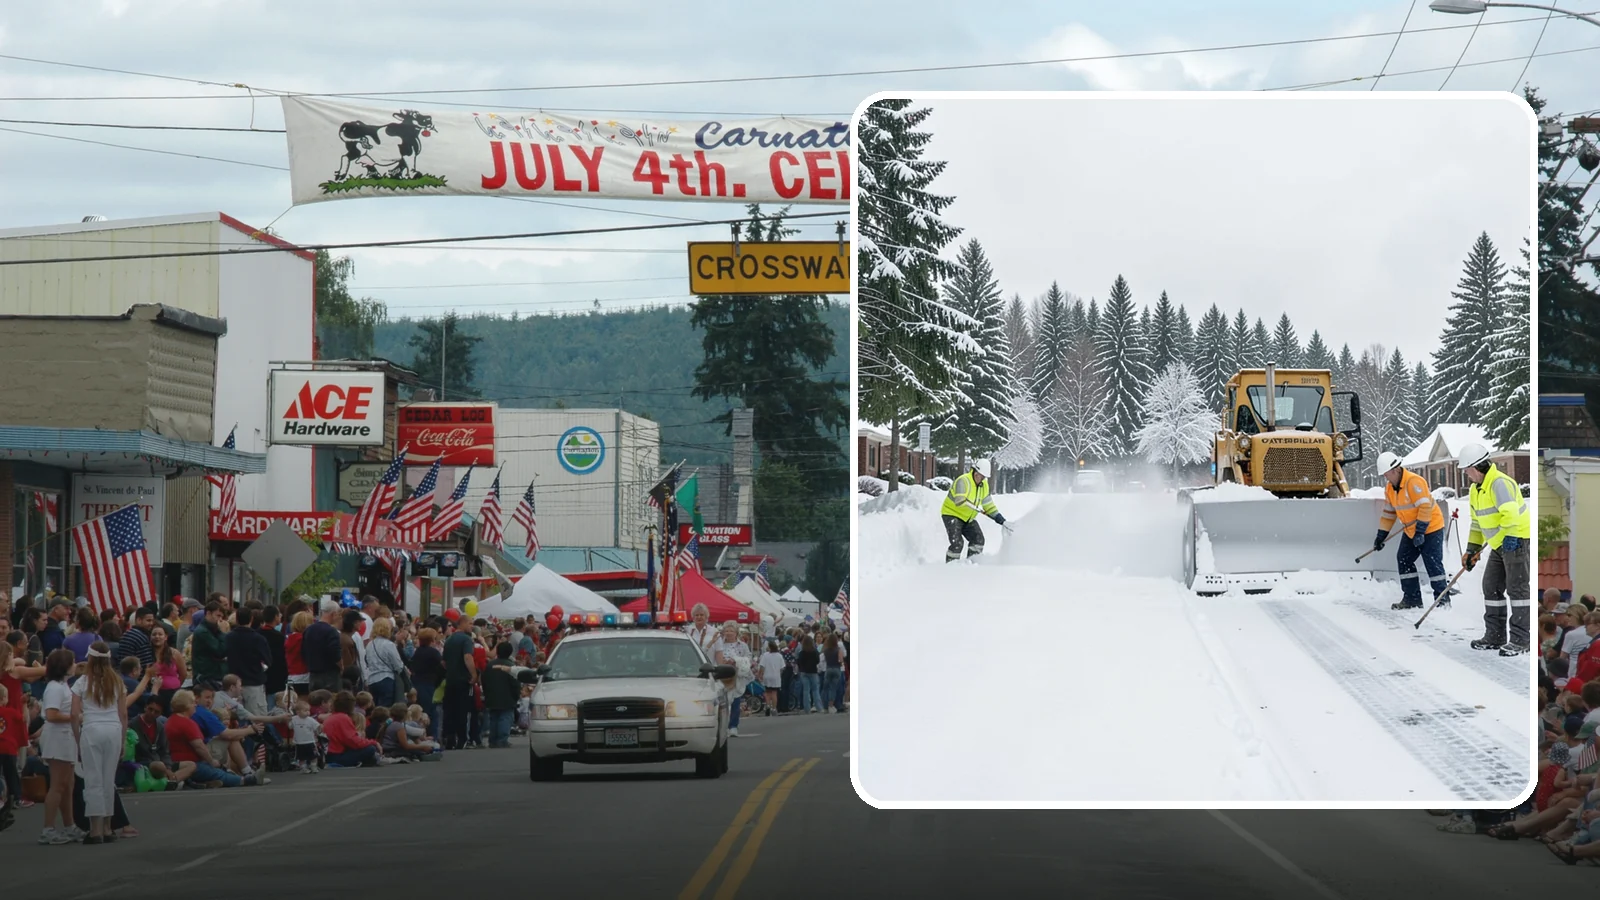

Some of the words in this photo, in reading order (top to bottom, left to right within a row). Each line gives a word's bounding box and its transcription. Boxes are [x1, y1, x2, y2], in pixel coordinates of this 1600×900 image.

[481, 141, 605, 193] JULY
[632, 150, 747, 197] 4th.
[696, 254, 851, 281] CROSSWA
[282, 379, 374, 420] ACE
[405, 409, 452, 422] CEDAR
[283, 421, 371, 437] Hardware
[416, 428, 477, 447] Coca-Cola
[353, 467, 387, 479] Simpl
[95, 485, 124, 495] Vincent
[125, 486, 136, 495] de
[137, 486, 155, 495] Paul
[699, 535, 730, 543] GLASS
